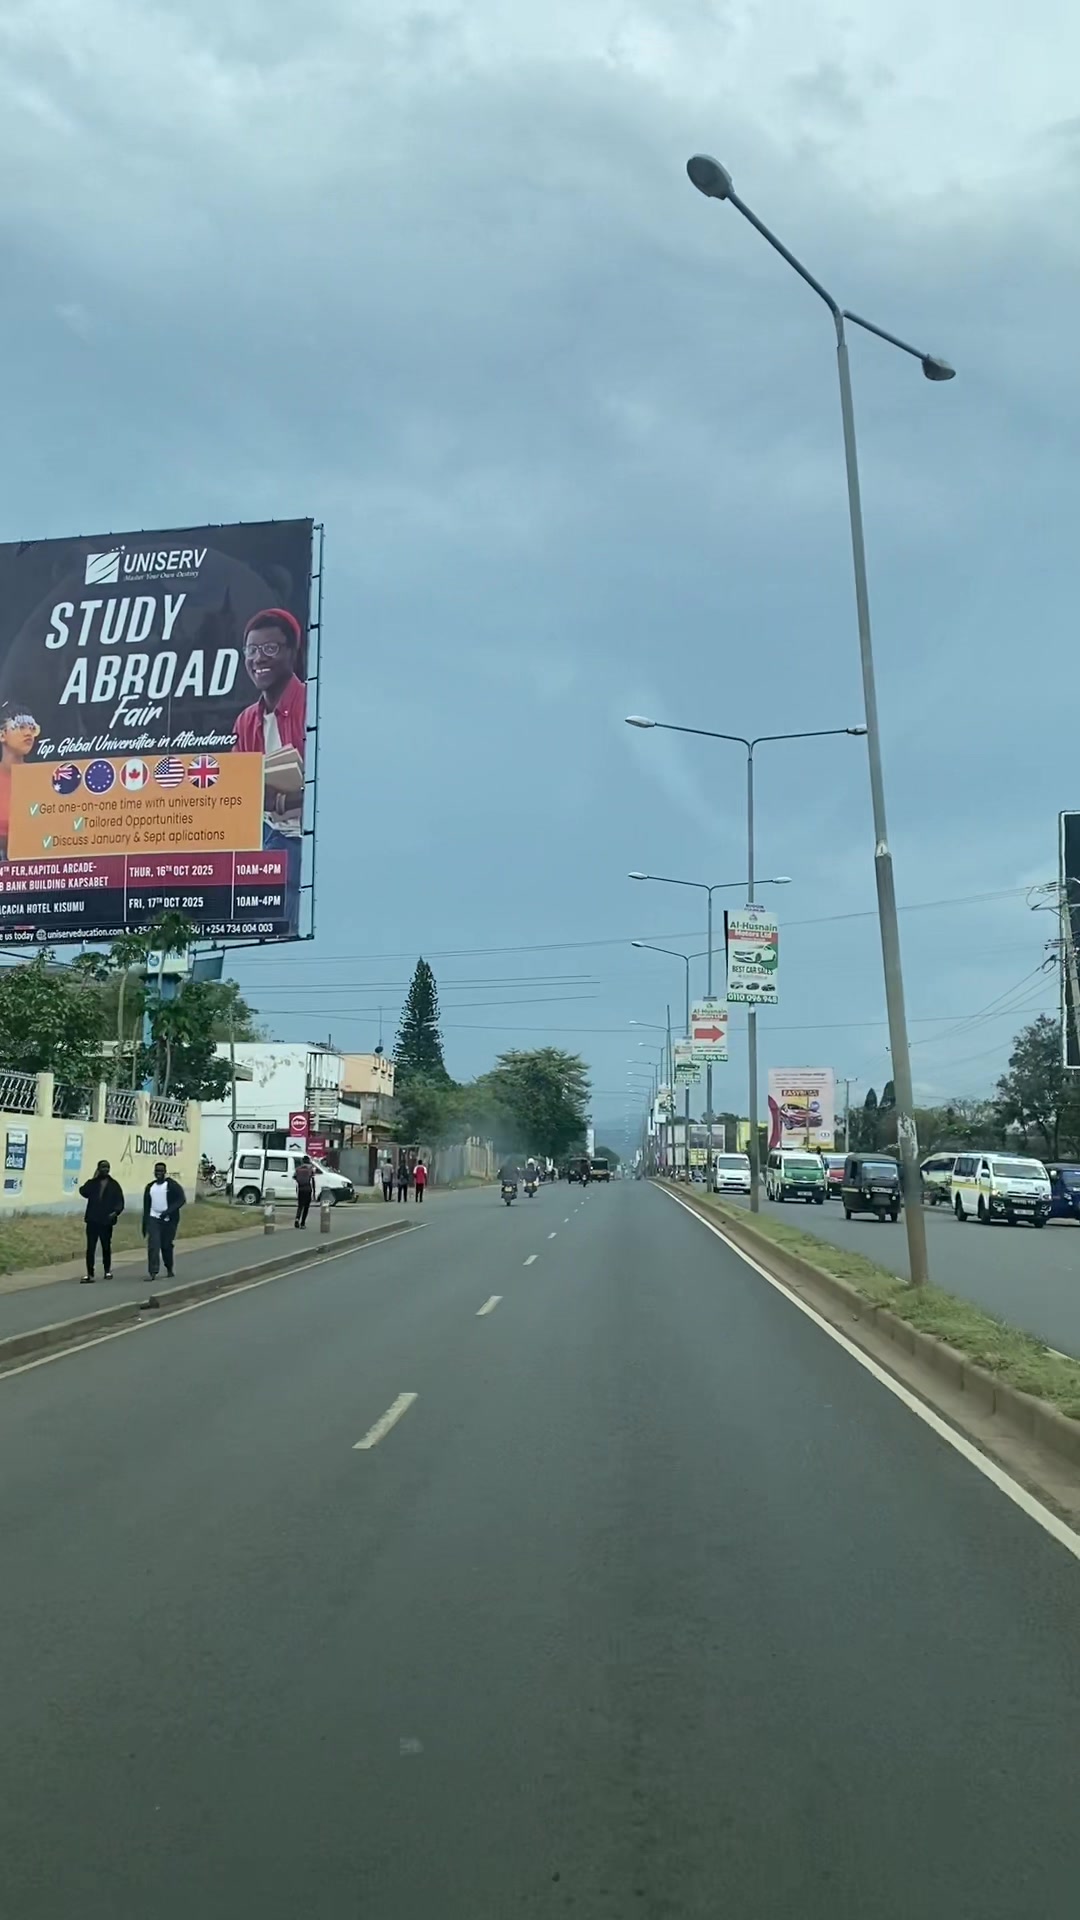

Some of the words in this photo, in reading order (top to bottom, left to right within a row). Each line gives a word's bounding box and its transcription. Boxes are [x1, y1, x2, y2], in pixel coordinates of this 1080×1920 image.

[124, 548, 207, 573] UNISERV
[176, 570, 199, 578] Destiny
[45, 593, 187, 649] STUDY
[58, 648, 240, 705] ABROAD
[108, 694, 163, 729] Fair
[37, 738, 55, 759] Top
[57, 735, 95, 756] Global
[95, 733, 157, 751] Universities
[157, 735, 170, 747] in
[170, 730, 238, 748] Attendance
[40, 803, 55, 815] Get
[58, 801, 118, 813] one-on-one
[120, 798, 142, 809] time
[145, 796, 165, 808] with
[168, 795, 217, 810] university
[220, 796, 242, 810] reps
[84, 815, 123, 828] Tailored
[125, 813, 193, 829] Opportunities
[53, 834, 88, 847] Discuss
[90, 832, 131, 848] January
[133, 832, 141, 842] &
[143, 831, 166, 844] Sept
[168, 829, 225, 843] aplications
[62, 862, 98, 874] ARCADE-
[129, 866, 154, 878] THUR,
[156, 865, 173, 876] 16TH
[173, 865, 189, 876] OCT
[192, 865, 213, 876] 2025
[236, 863, 281, 876] 10AM-4PM
[6, 881, 28, 892] BANK
[29, 878, 66, 890] BUILDING
[68, 876, 109, 888] KAPSABET
[26, 903, 52, 914] HOTEL
[53, 901, 85, 913] KISUMU
[128, 898, 146, 910] FRI,
[147, 897, 163, 908] 17TH
[163, 897, 179, 907] OCT
[182, 896, 204, 907] 2025
[236, 896, 281, 907] 10AM-4PM
[4, 932, 13, 941] us
[14, 930, 35, 942] today
[48, 927, 124, 939] uniserveducation.com
[206, 924, 226, 934] +254
[226, 924, 241, 933] 734
[242, 923, 257, 933] 004
[258, 922, 274, 932] 003
[730, 921, 778, 932] Al-Husnain
[732, 965, 746, 973] BEST
[746, 966, 757, 974] CAR
[728, 992, 745, 1001] 0110
[256, 1122, 274, 1130] Road
[135, 1135, 177, 1157] DuraCoat
